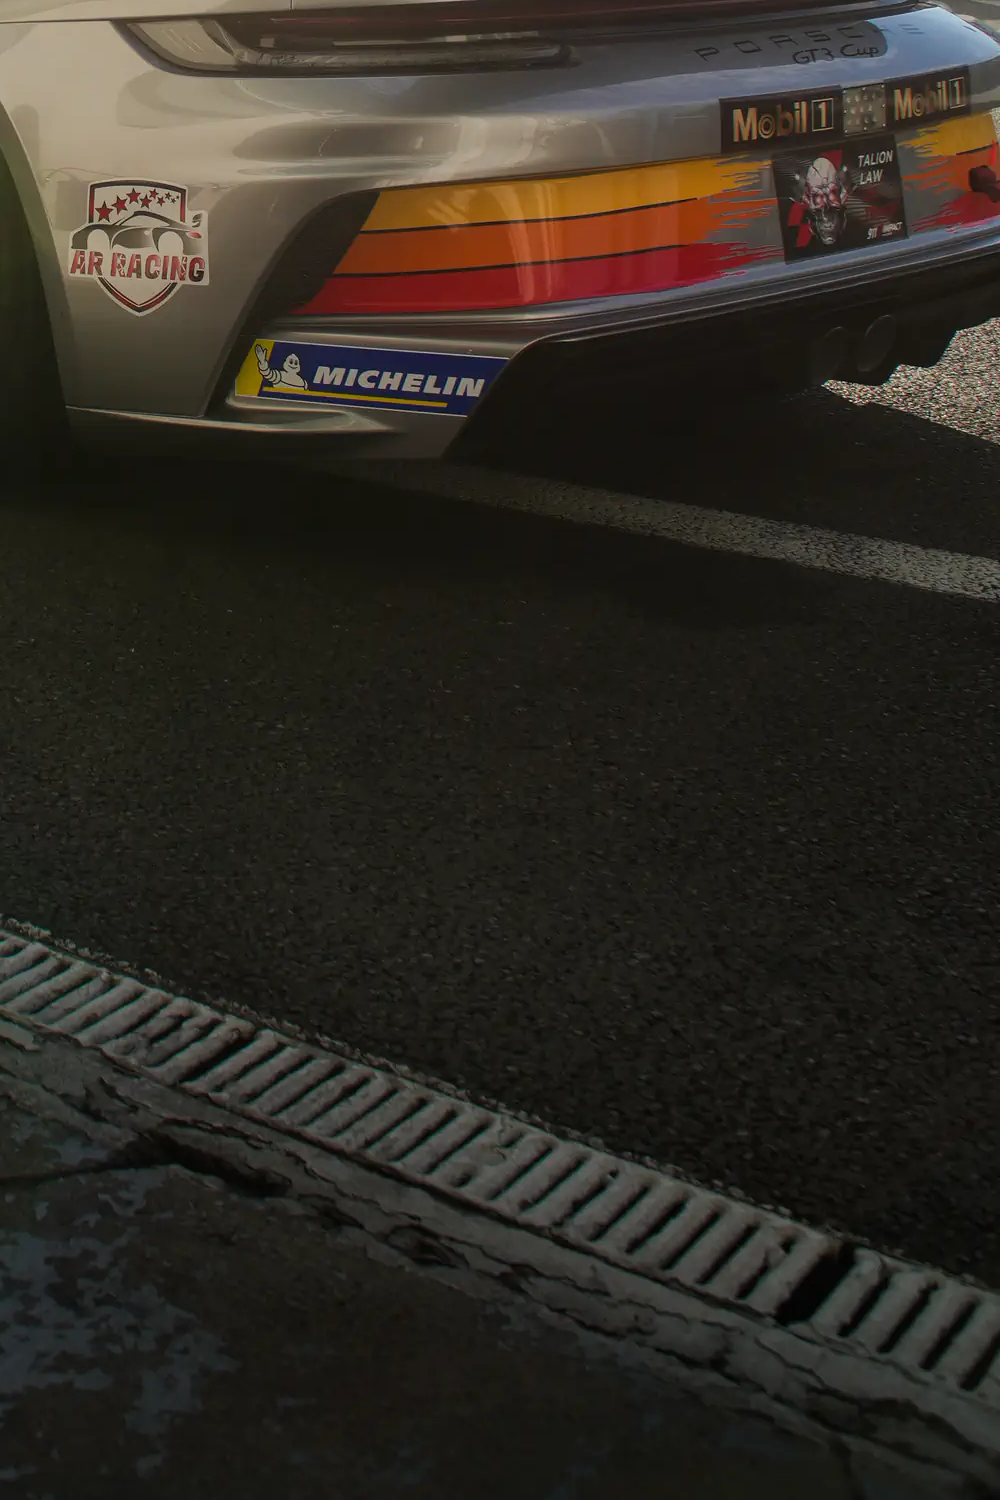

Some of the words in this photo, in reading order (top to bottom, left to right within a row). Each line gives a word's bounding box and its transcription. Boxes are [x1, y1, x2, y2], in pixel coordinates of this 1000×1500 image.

[792, 49, 834, 65] GT3
[840, 43, 880, 58] Cup
[894, 80, 948, 120] Mobil
[733, 101, 808, 142] Mobil
[858, 150, 893, 168] TALION
[860, 169, 883, 185] LAW
[70, 250, 104, 277] AR
[110, 252, 206, 282] RACING
[313, 365, 486, 398] MICHELIN
